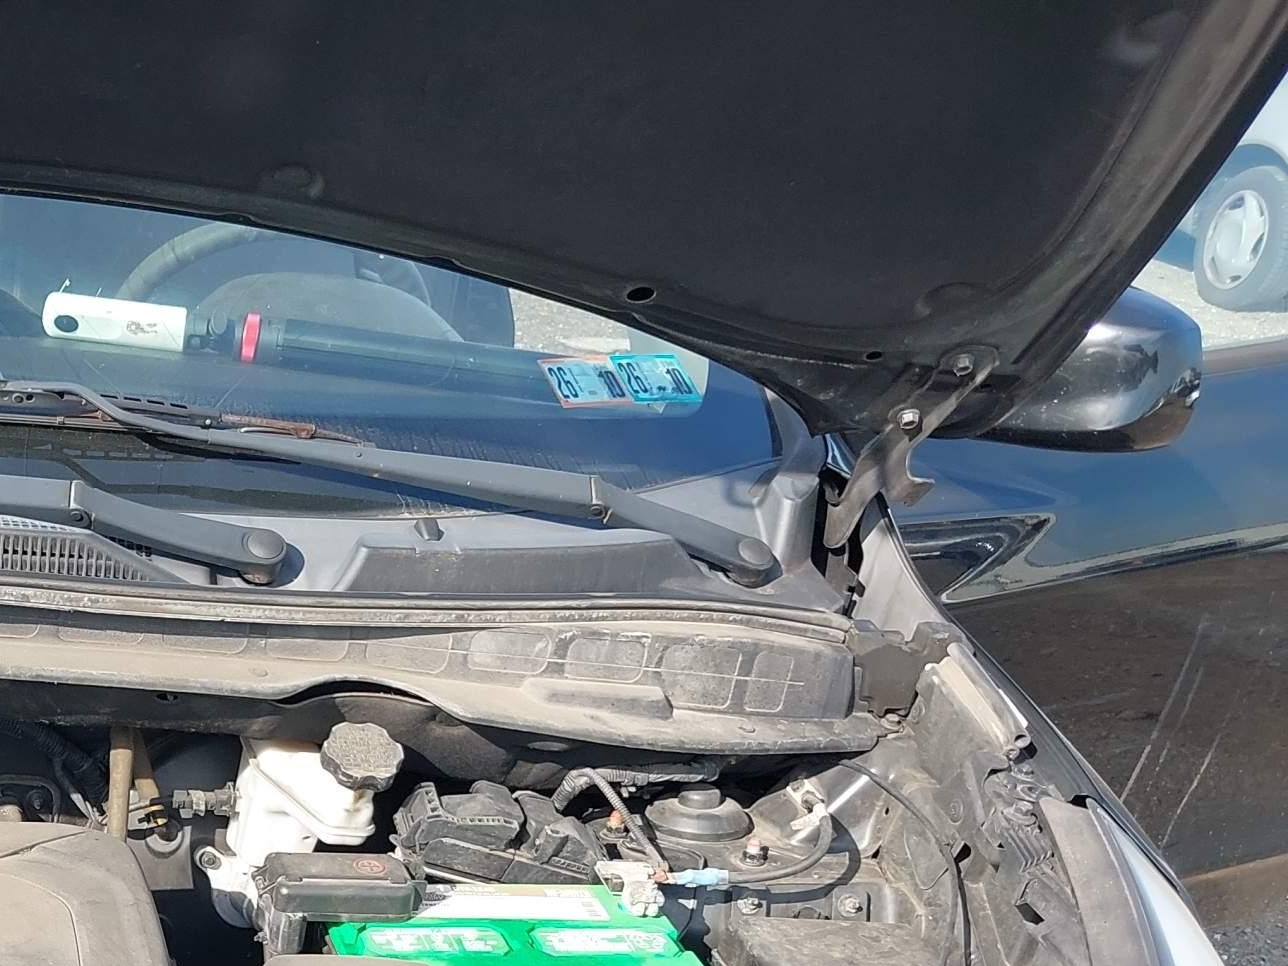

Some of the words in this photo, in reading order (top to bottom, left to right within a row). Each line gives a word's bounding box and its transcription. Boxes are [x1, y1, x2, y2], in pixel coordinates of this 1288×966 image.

[547, 366, 579, 399] 26
[598, 370, 626, 398] 10
[617, 361, 649, 393] 26
[665, 367, 693, 395] 10
